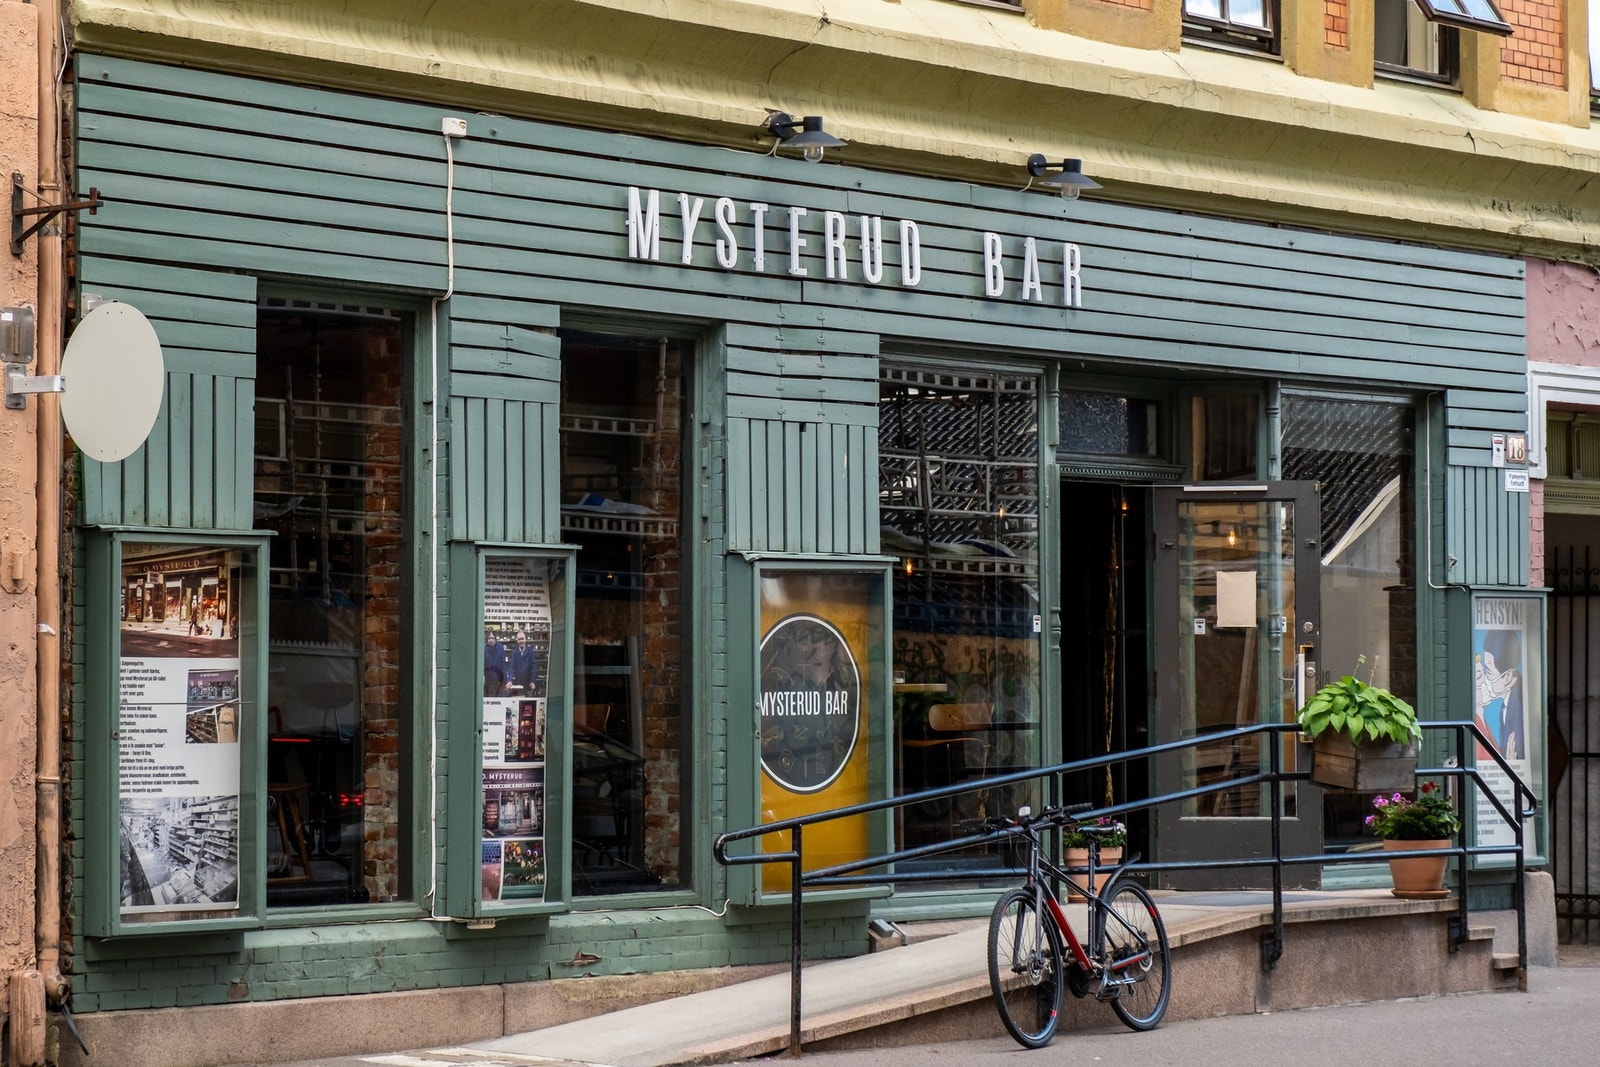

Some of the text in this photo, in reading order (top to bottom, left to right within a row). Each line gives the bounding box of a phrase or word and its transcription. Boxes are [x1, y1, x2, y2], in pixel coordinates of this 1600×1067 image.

[627, 186, 1082, 307] MYSTERUD BAR
[1510, 439, 1524, 460] 18
[152, 559, 200, 572] MYSTERUD
[1476, 600, 1522, 626] HENSYN!
[760, 690, 848, 716] MYSTERUD BAR
